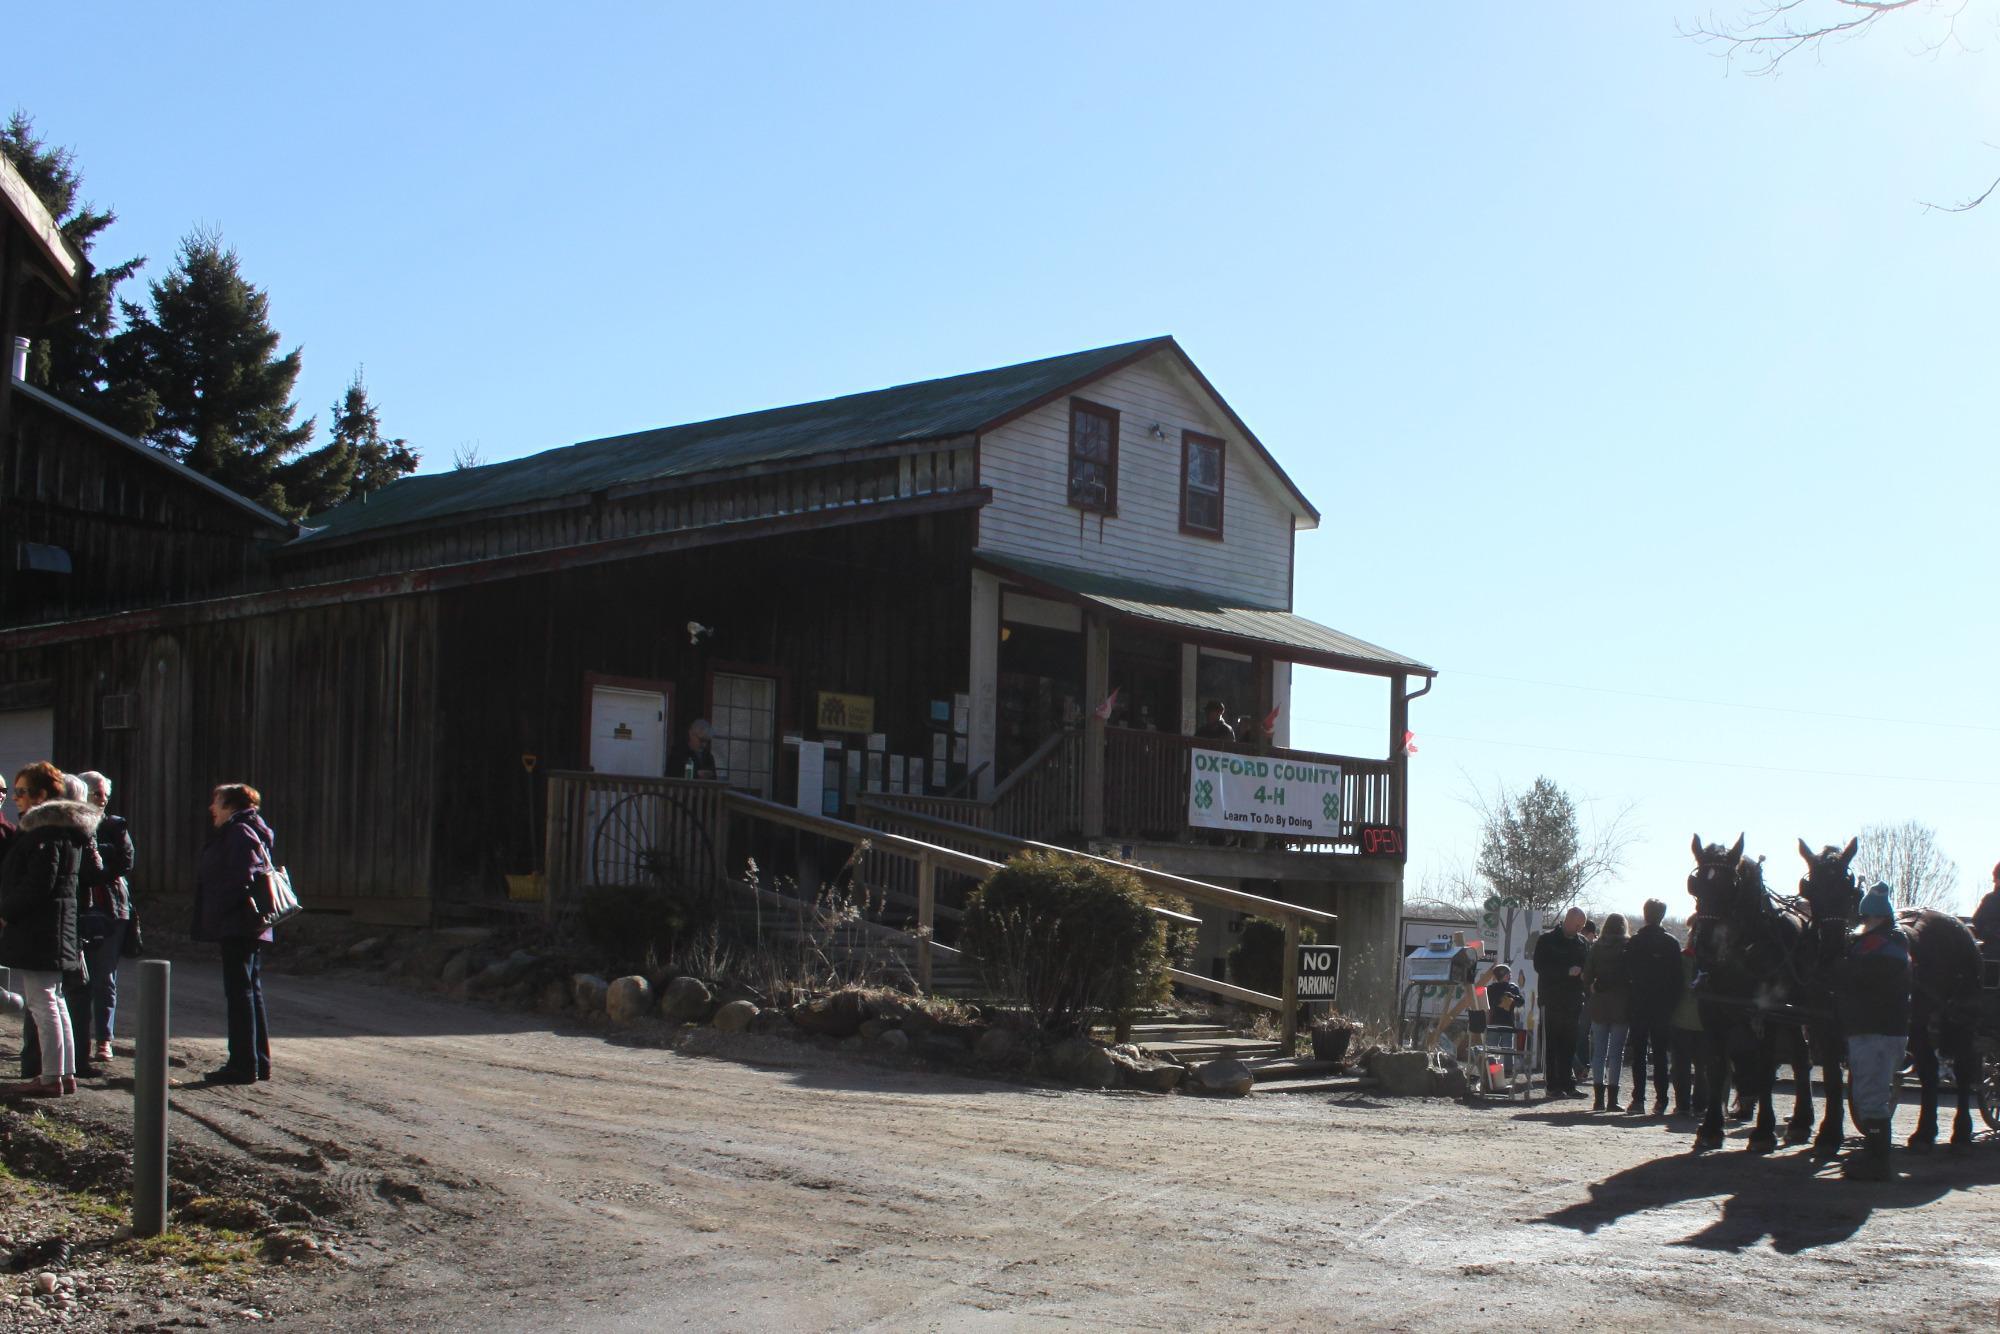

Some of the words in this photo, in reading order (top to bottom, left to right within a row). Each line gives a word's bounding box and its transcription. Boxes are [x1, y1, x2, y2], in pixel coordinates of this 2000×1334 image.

[1195, 754, 1269, 778] OXFORD
[1273, 764, 1339, 785] COUNTY
[1254, 785, 1285, 805] 4-H
[1224, 810, 1248, 822] Learn
[1250, 812, 1262, 823] To
[1264, 814, 1274, 824] Do
[1276, 815, 1286, 828] By
[1288, 816, 1313, 830] Doing
[1363, 828, 1403, 853] OPEN
[1303, 951, 1331, 971] NO
[1297, 975, 1335, 995] PARKING
